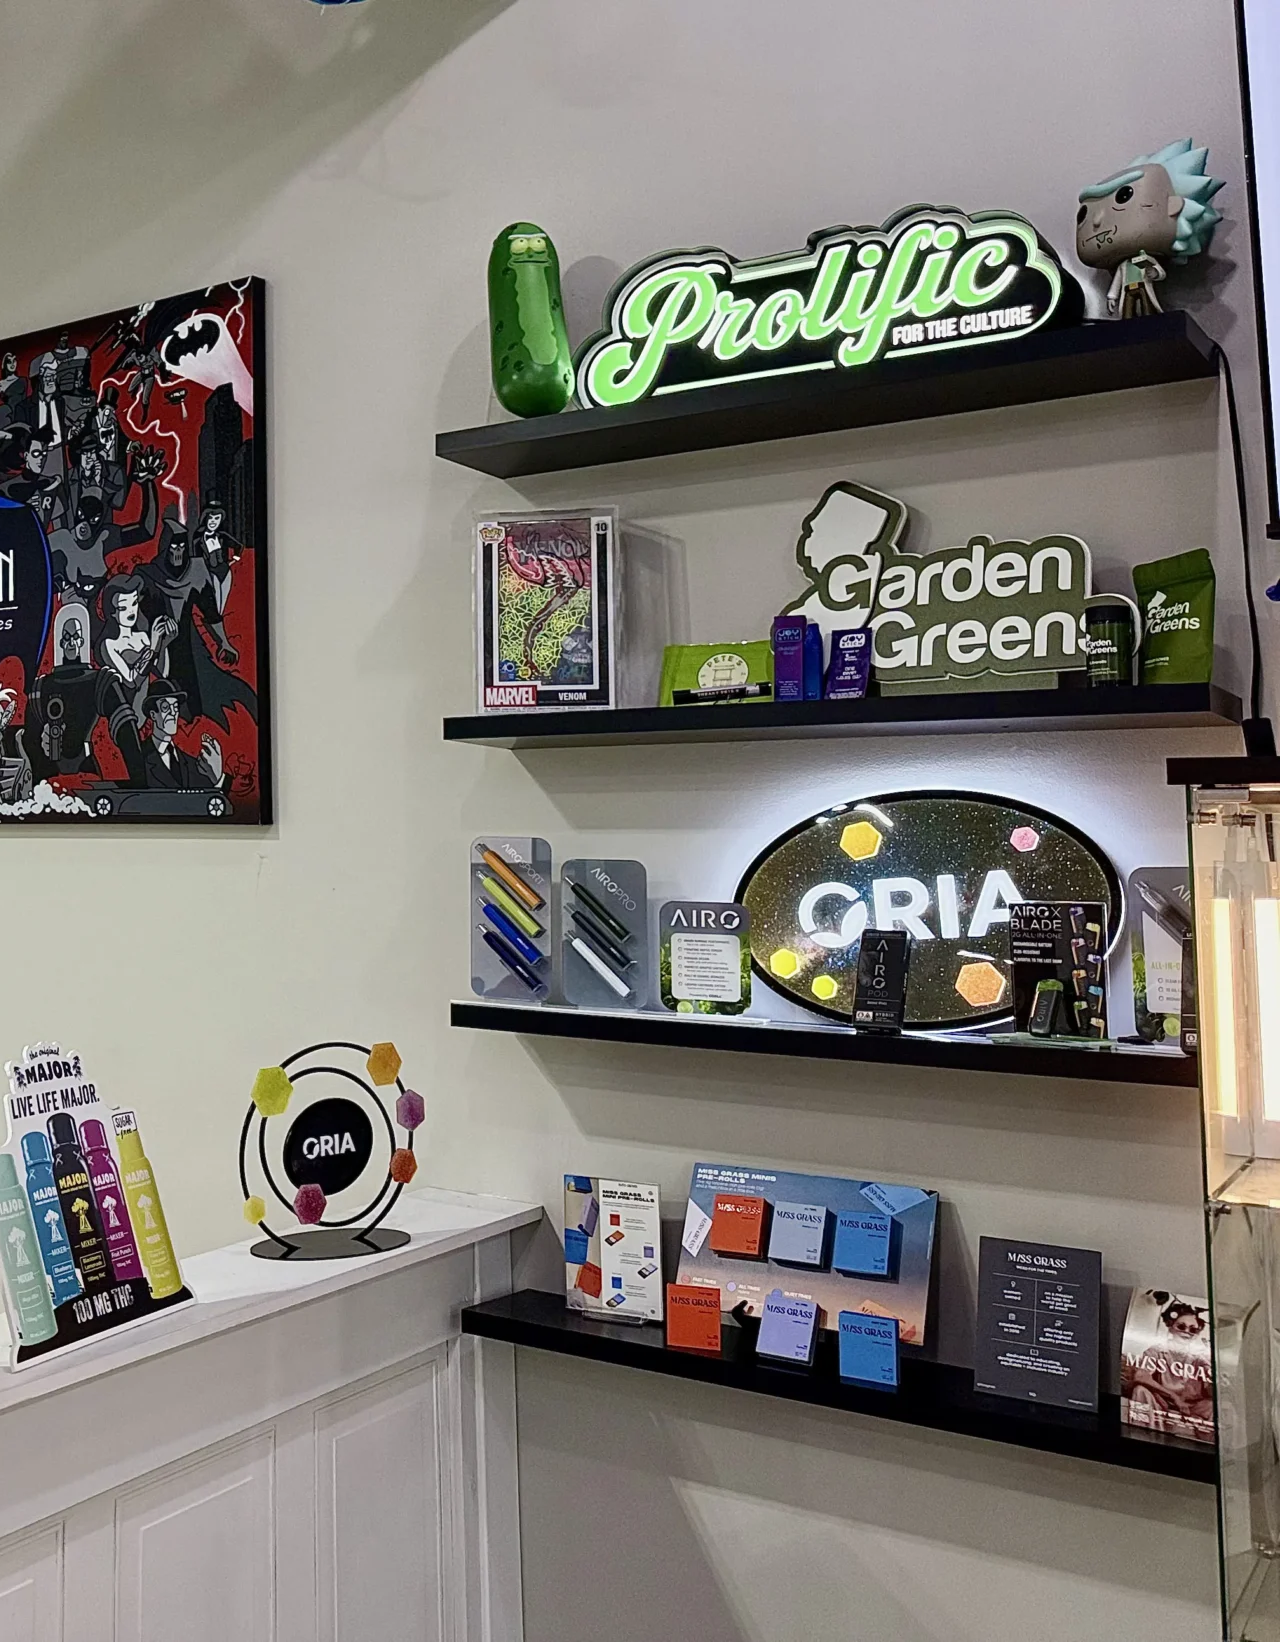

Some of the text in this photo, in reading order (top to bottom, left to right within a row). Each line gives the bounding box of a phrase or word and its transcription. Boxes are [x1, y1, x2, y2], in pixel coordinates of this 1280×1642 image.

[588, 222, 1019, 407] Prolific
[892, 305, 1034, 346] FOR THE CULTURE
[595, 522, 607, 532] 10
[819, 545, 1072, 611] Garden
[1147, 601, 1190, 619] Garden
[1149, 616, 1200, 634] Greens
[778, 629, 800, 637] JOY
[842, 635, 864, 643] JOY
[870, 611, 1092, 669] Green
[706, 655, 743, 668] PETE'S
[485, 686, 536, 706] MARVEL
[558, 692, 587, 701] VENOM
[798, 869, 1023, 948] ORIA
[1011, 906, 1062, 918] AIRO X
[670, 908, 740, 930] AIRO
[1010, 918, 1062, 931] BLADE
[872, 939, 889, 989] AIRO
[867, 989, 889, 998] POD
[29, 1046, 60, 1060] the original
[25, 1060, 73, 1085] MAJOR
[10, 1083, 100, 1120] LIVE LIFE MAJOR.
[114, 1114, 133, 1129] SUGAR
[302, 1131, 356, 1160] ORIA
[58, 1172, 88, 1190] MAJOR
[92, 1172, 115, 1187] MAJOR
[125, 1169, 150, 1184] MAJOR
[696, 1173, 746, 1184] PRE-ROLLS
[720, 1170, 750, 1179] GRASS
[751, 1173, 777, 1182] MINIS
[33, 1186, 58, 1201] MAJOR
[617, 1195, 655, 1203] PRE-ROLLS
[776, 1210, 822, 1224] MISS GRASS
[839, 1219, 888, 1232] MISS GRASS
[80, 1237, 97, 1249] MIXER
[110, 1231, 124, 1241] MIXER
[51, 1246, 67, 1256] MIXER
[1007, 1252, 1067, 1269] MISS GRASS
[72, 1297, 94, 1324] 100
[93, 1292, 113, 1317] MG
[110, 1284, 134, 1310] THC
[670, 1296, 718, 1308] MISS GRASS
[766, 1304, 813, 1319] MISS GRASS
[841, 1323, 893, 1339] MISS GRASS
[1126, 1352, 1214, 1384] MISS GRAS
